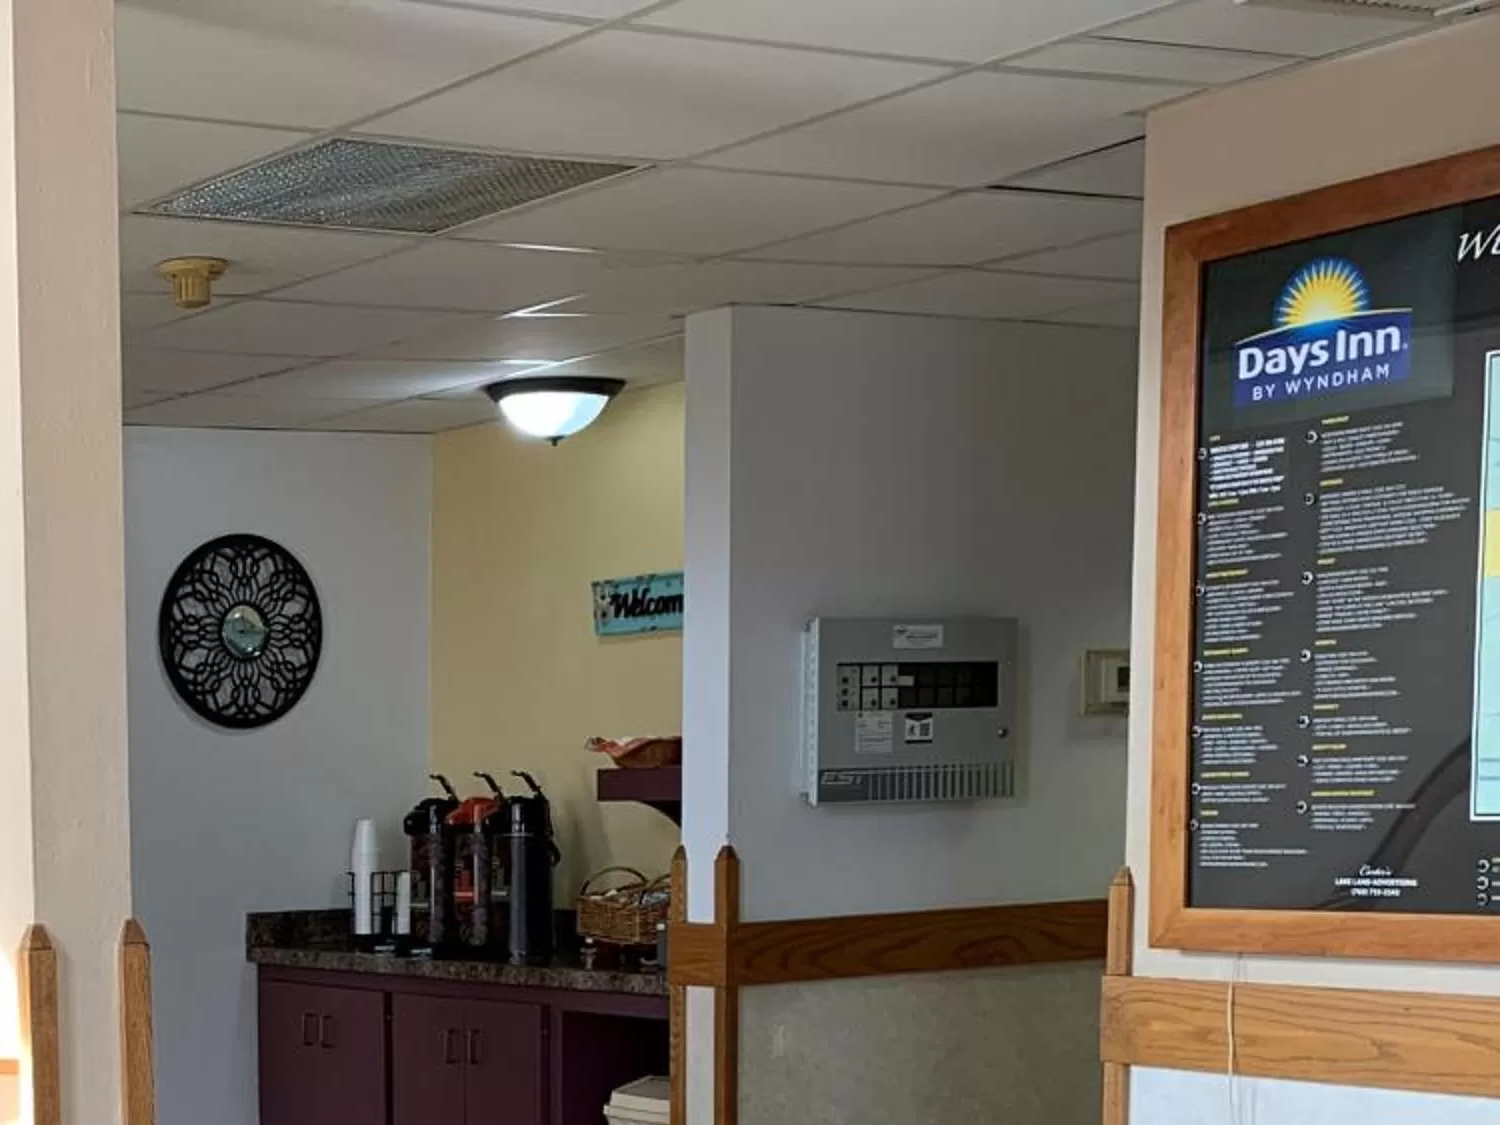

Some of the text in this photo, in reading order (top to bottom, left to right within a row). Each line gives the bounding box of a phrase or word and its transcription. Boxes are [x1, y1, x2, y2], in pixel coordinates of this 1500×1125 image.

[1238, 325, 1402, 380] Days Inn
[1252, 363, 1391, 401] BY WYNDHAM
[610, 587, 684, 618] Welcom
